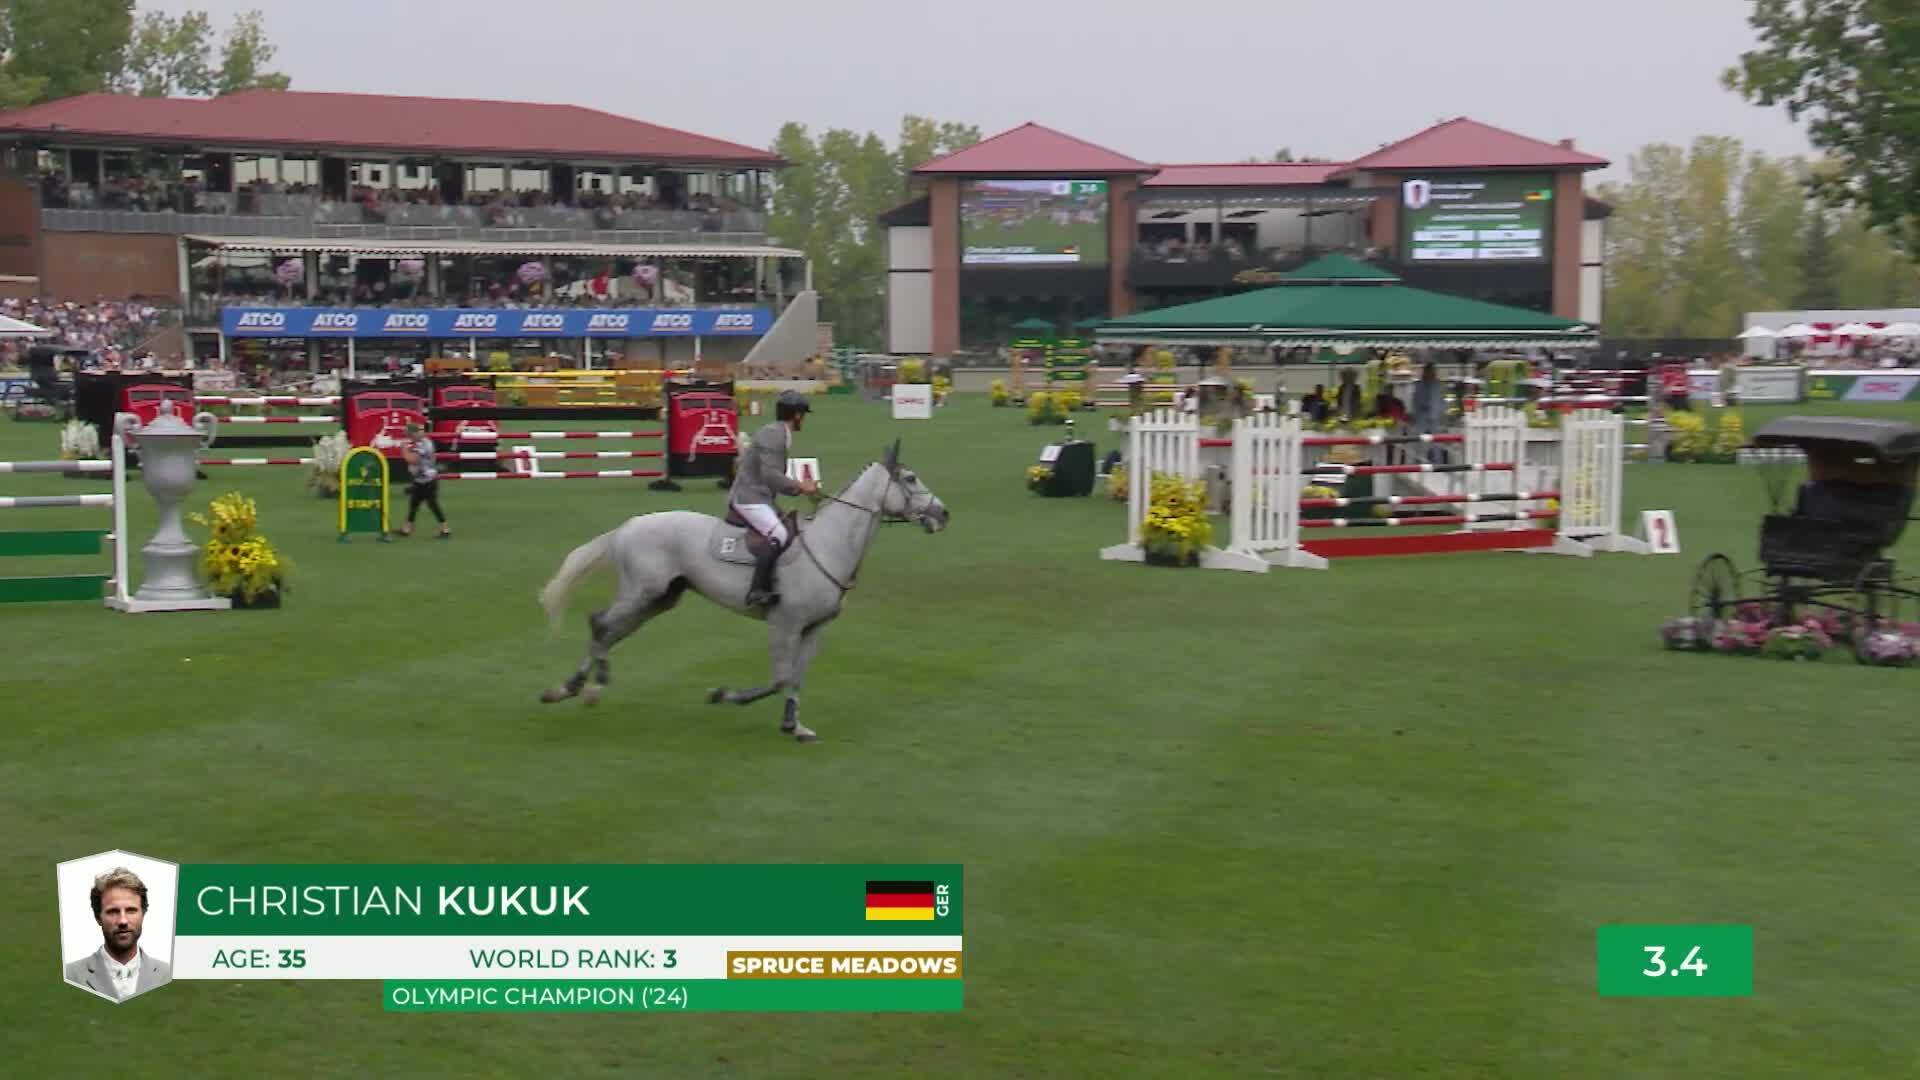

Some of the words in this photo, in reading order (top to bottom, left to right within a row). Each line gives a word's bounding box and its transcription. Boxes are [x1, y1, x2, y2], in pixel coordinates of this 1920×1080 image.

[238, 312, 285, 326] ATCO
[313, 313, 358, 326] ATCO
[384, 313, 429, 326] ATCO
[453, 314, 497, 327] ATCO
[522, 313, 565, 327] ATCO
[587, 314, 629, 326] ATCO
[652, 314, 693, 326] ATCO
[713, 313, 753, 326] ATCO
